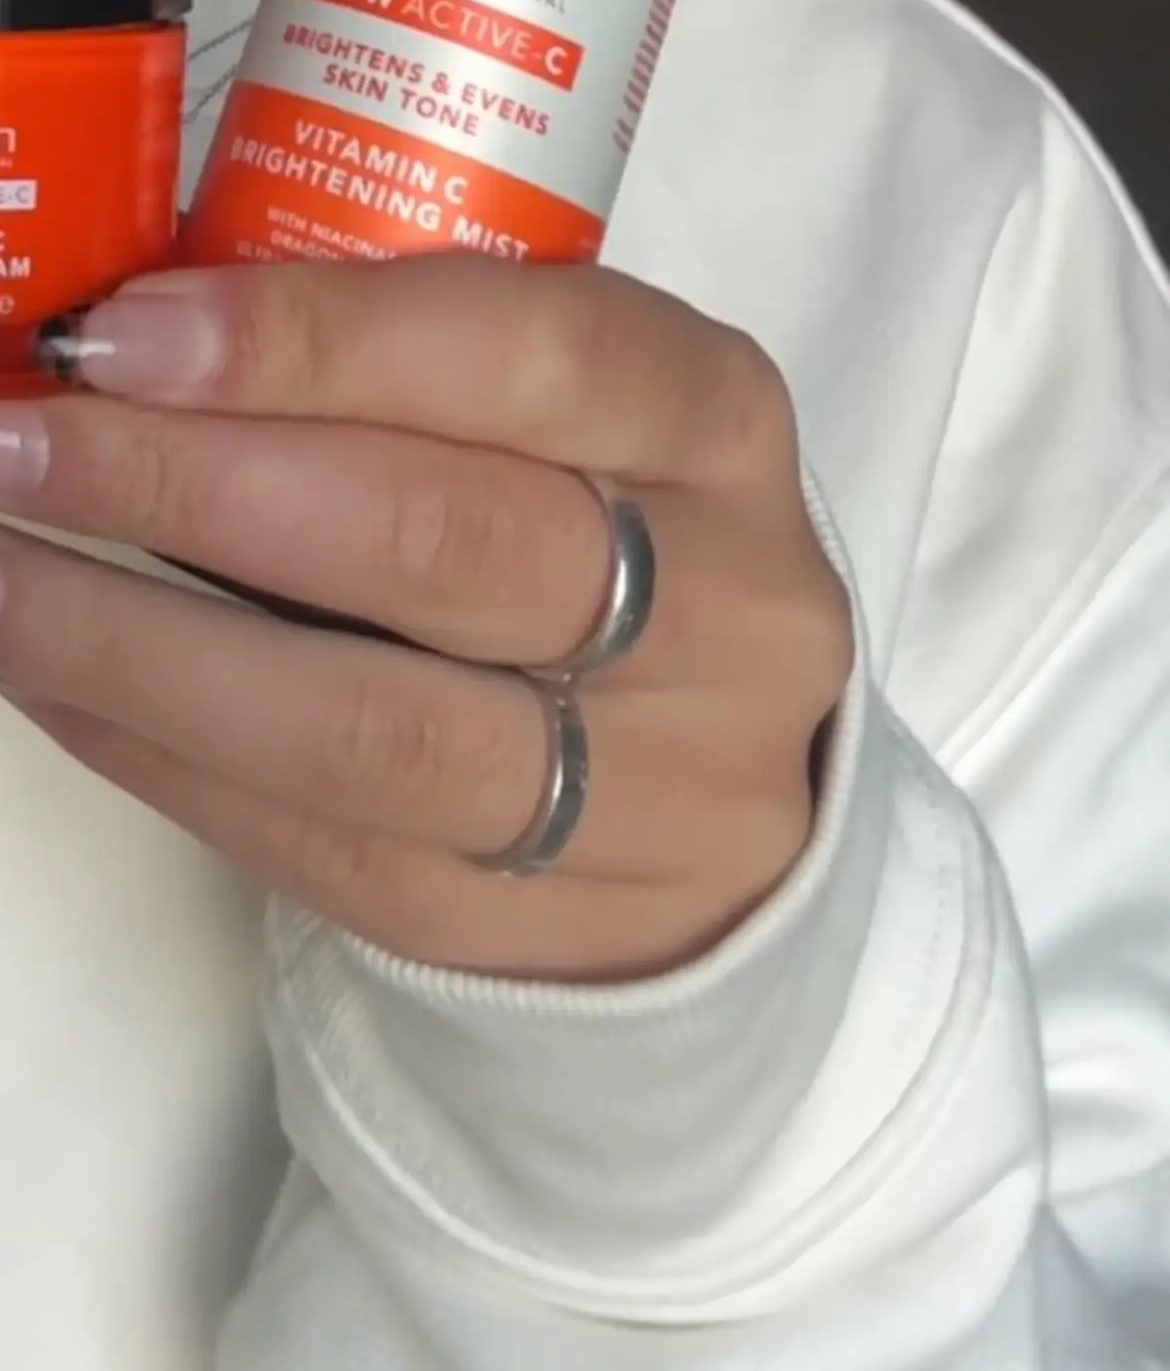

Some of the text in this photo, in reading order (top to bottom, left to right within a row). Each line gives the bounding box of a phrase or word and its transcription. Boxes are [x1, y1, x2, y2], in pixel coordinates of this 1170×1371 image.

[283, 24, 551, 137] BRIGHTENS & EVENS
[323, 63, 480, 137] SKIN TONE
[230, 135, 530, 262] BRIGHTENING MIST
[294, 119, 470, 205] VITAMIN C
